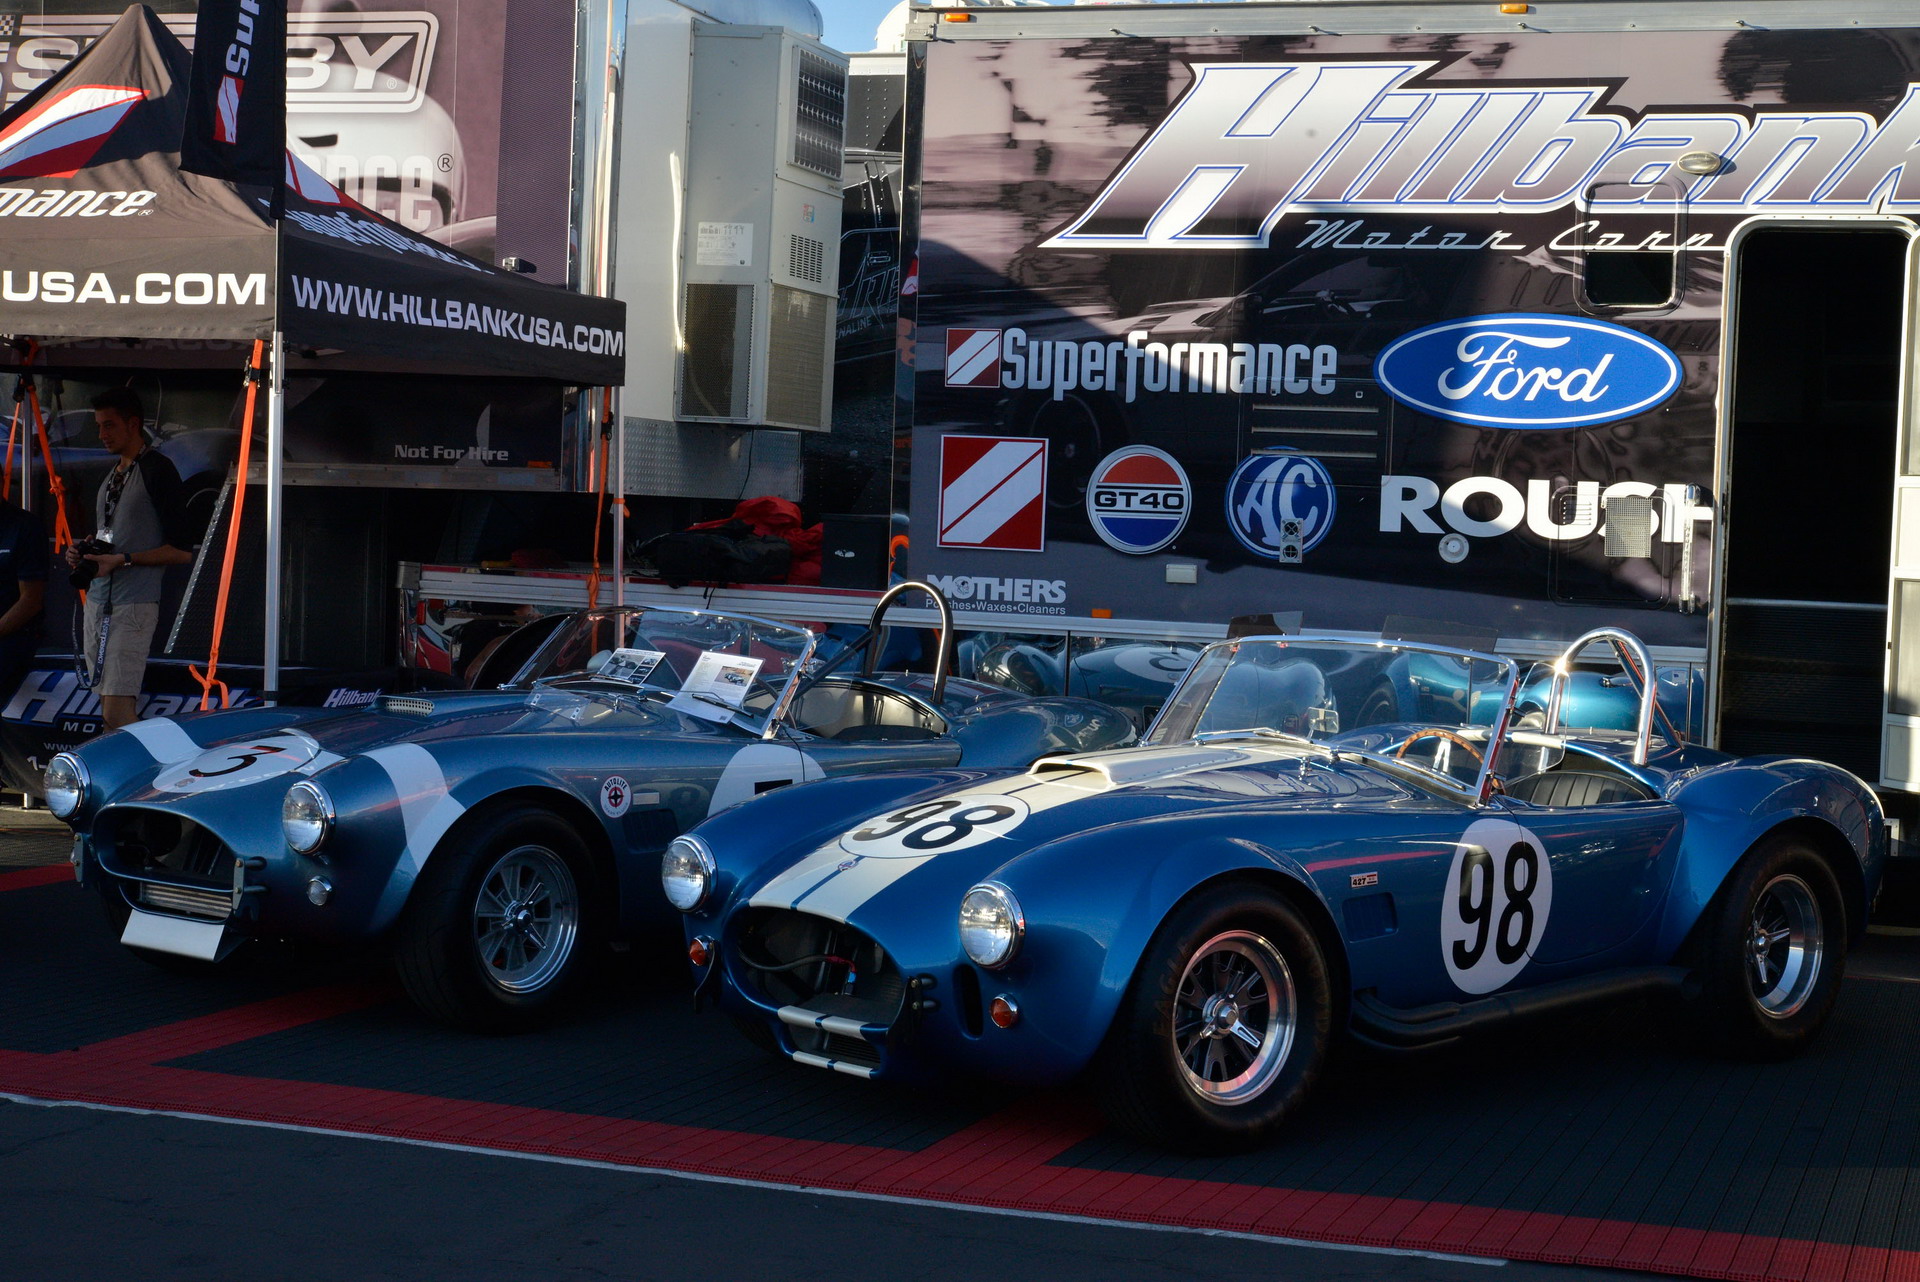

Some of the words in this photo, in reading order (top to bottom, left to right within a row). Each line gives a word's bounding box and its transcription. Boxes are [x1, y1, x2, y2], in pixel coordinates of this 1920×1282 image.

[1296, 220, 1526, 250] Motor
[1548, 220, 1728, 252] Corp
[291, 274, 624, 357] WWW.HILLBANKUSA.COM
[1002, 328, 1337, 403] Superformance
[1437, 331, 1614, 402] Ford
[394, 444, 430, 458] Not
[433, 445, 465, 459] For
[468, 446, 509, 461] Hire
[1094, 490, 1184, 510] GT40
[1237, 457, 1319, 547] AC
[926, 574, 1067, 604] MOTHERS
[604, 777, 627, 791] AUTOLITE
[853, 800, 1015, 850] 98
[1353, 877, 1366, 886] 427
[1453, 841, 1538, 970] 98
